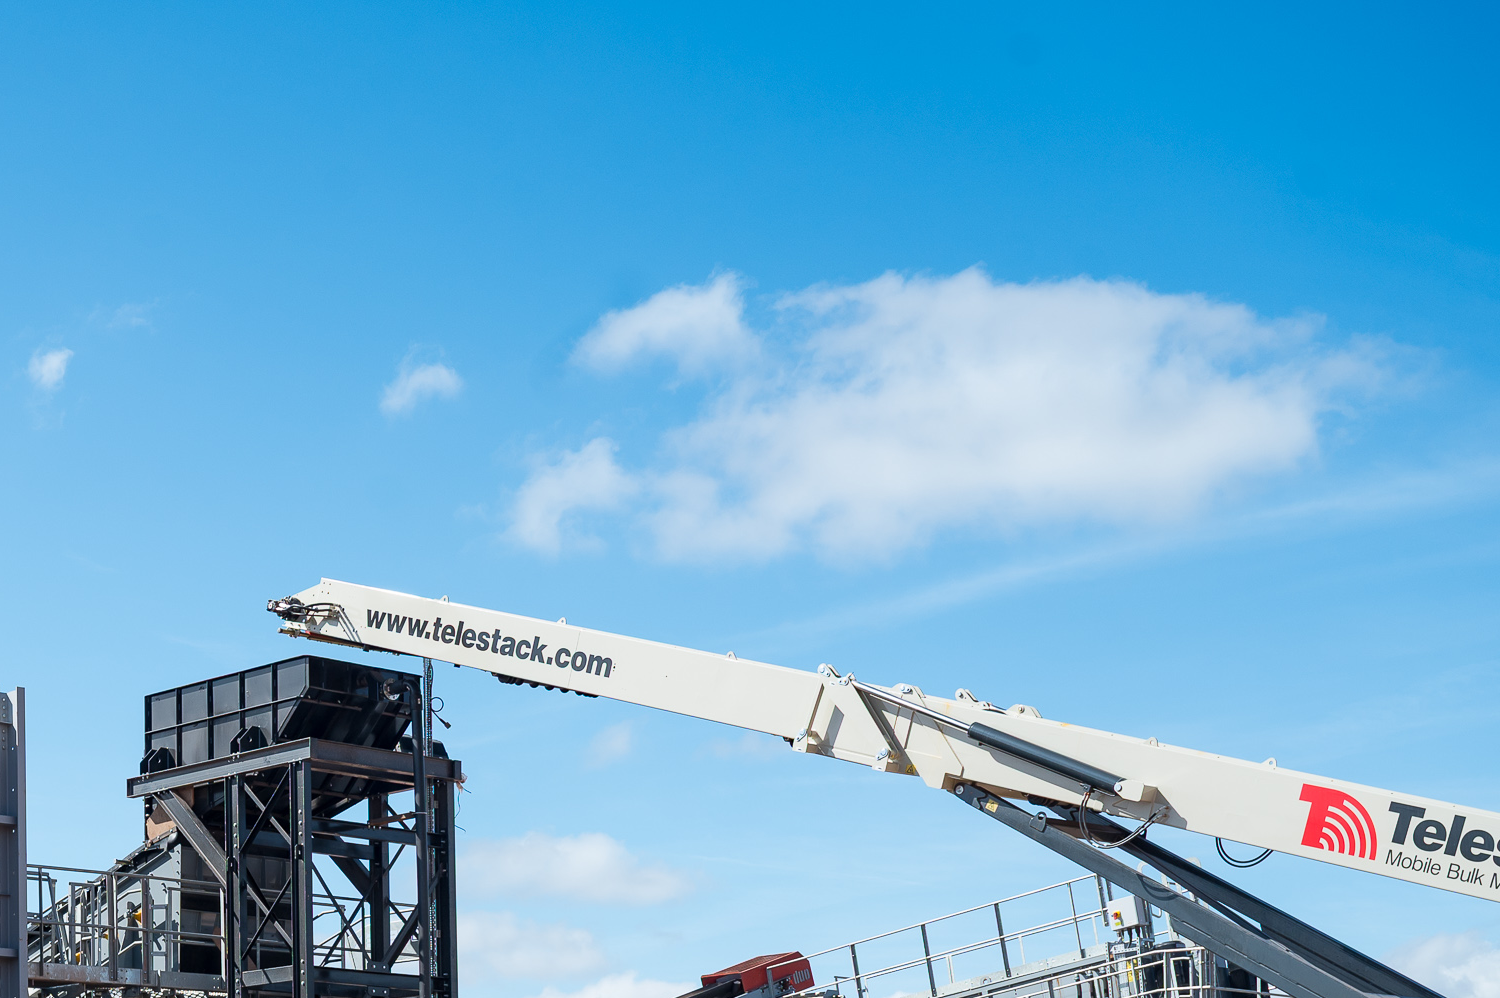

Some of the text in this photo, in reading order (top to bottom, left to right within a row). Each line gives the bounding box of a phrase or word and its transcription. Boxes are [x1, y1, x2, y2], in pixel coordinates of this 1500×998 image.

[366, 608, 613, 678] www.telestack.com
[1384, 848, 1442, 876] Mobile
[1446, 862, 1486, 886] Bulk
